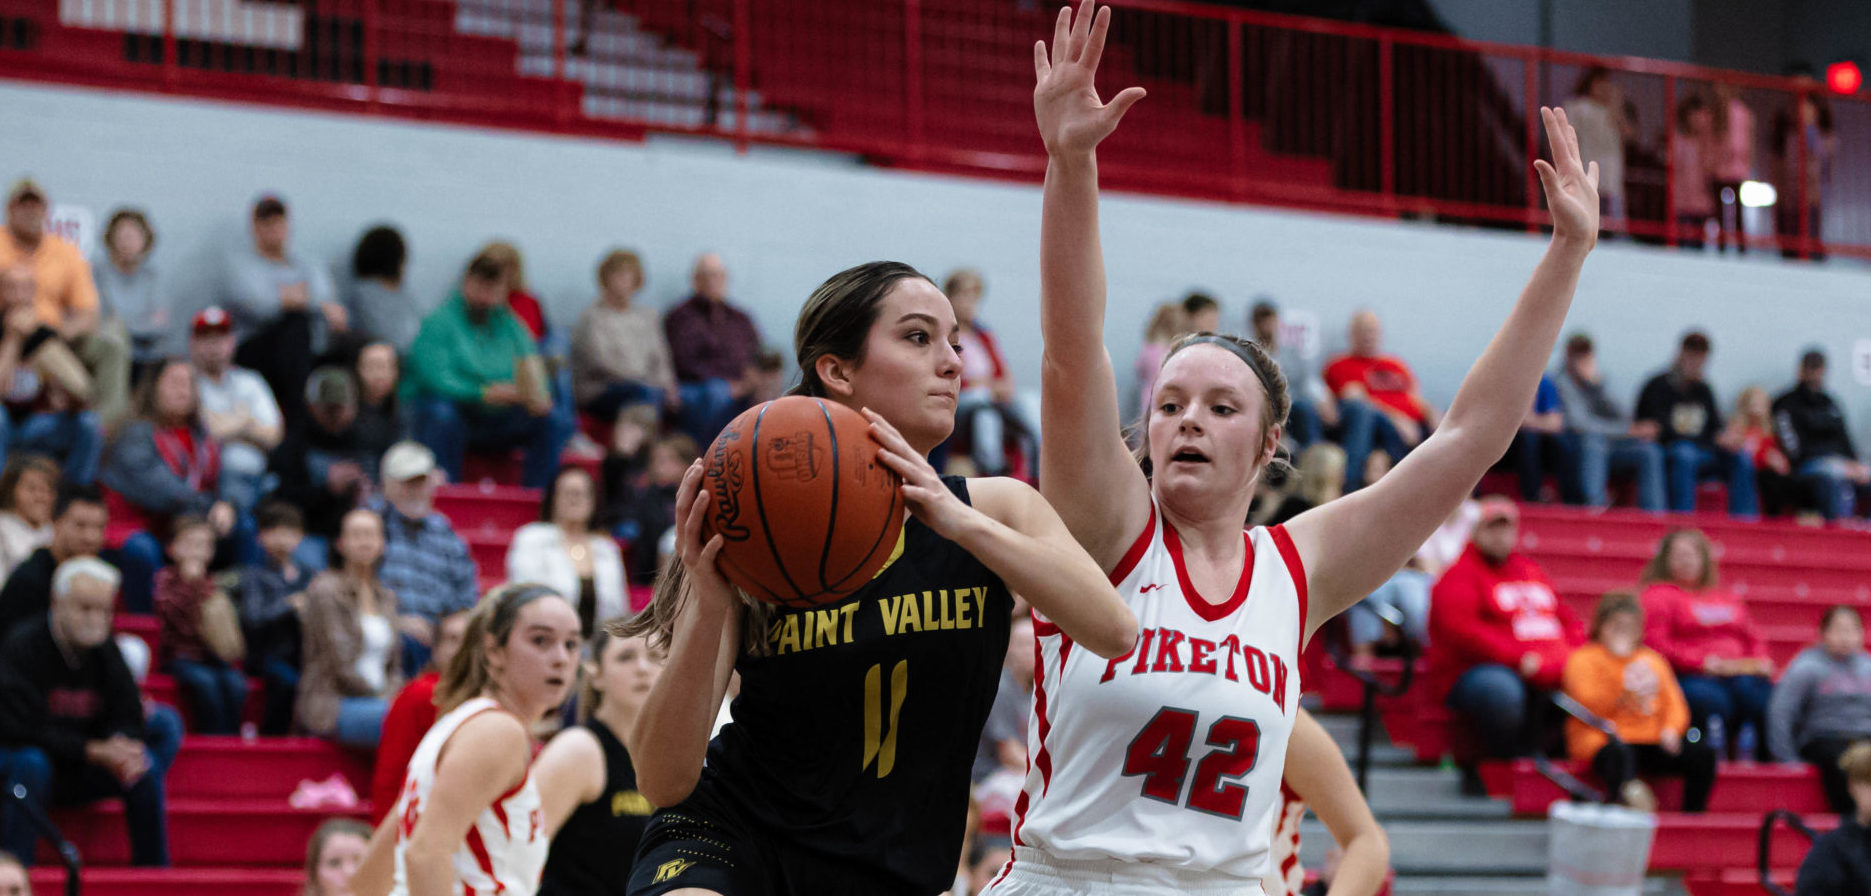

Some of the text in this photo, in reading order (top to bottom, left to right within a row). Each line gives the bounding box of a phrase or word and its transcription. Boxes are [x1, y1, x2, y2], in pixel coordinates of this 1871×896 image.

[878, 586, 988, 636] VALLEY
[862, 659, 908, 779] 11
[1121, 706, 1262, 822] 42
